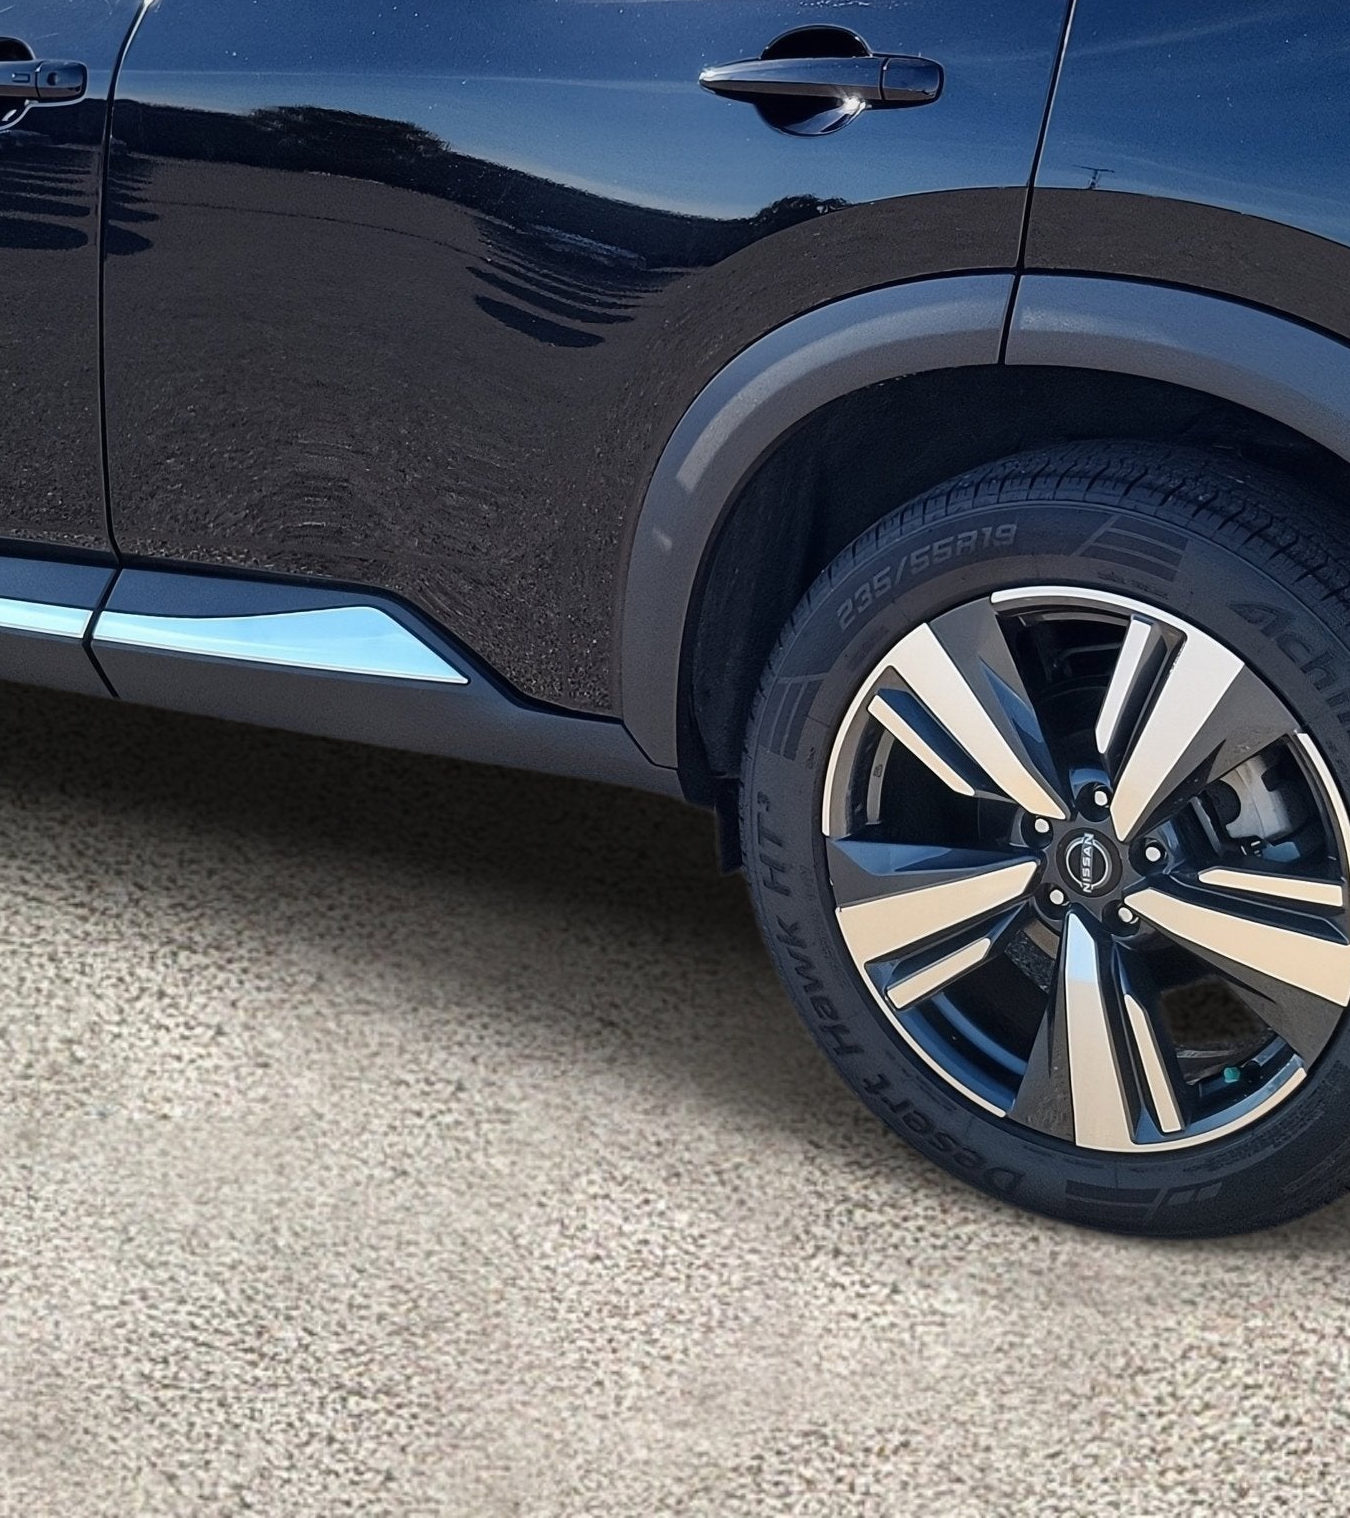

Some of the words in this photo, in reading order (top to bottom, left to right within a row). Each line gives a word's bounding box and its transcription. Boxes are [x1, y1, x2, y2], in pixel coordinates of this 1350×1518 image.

[836, 523, 1018, 632] 235/55R19
[1080, 832, 1095, 893] NISSAN
[776, 914, 865, 1056] Hawk
[862, 1073, 1027, 1194] Desert
